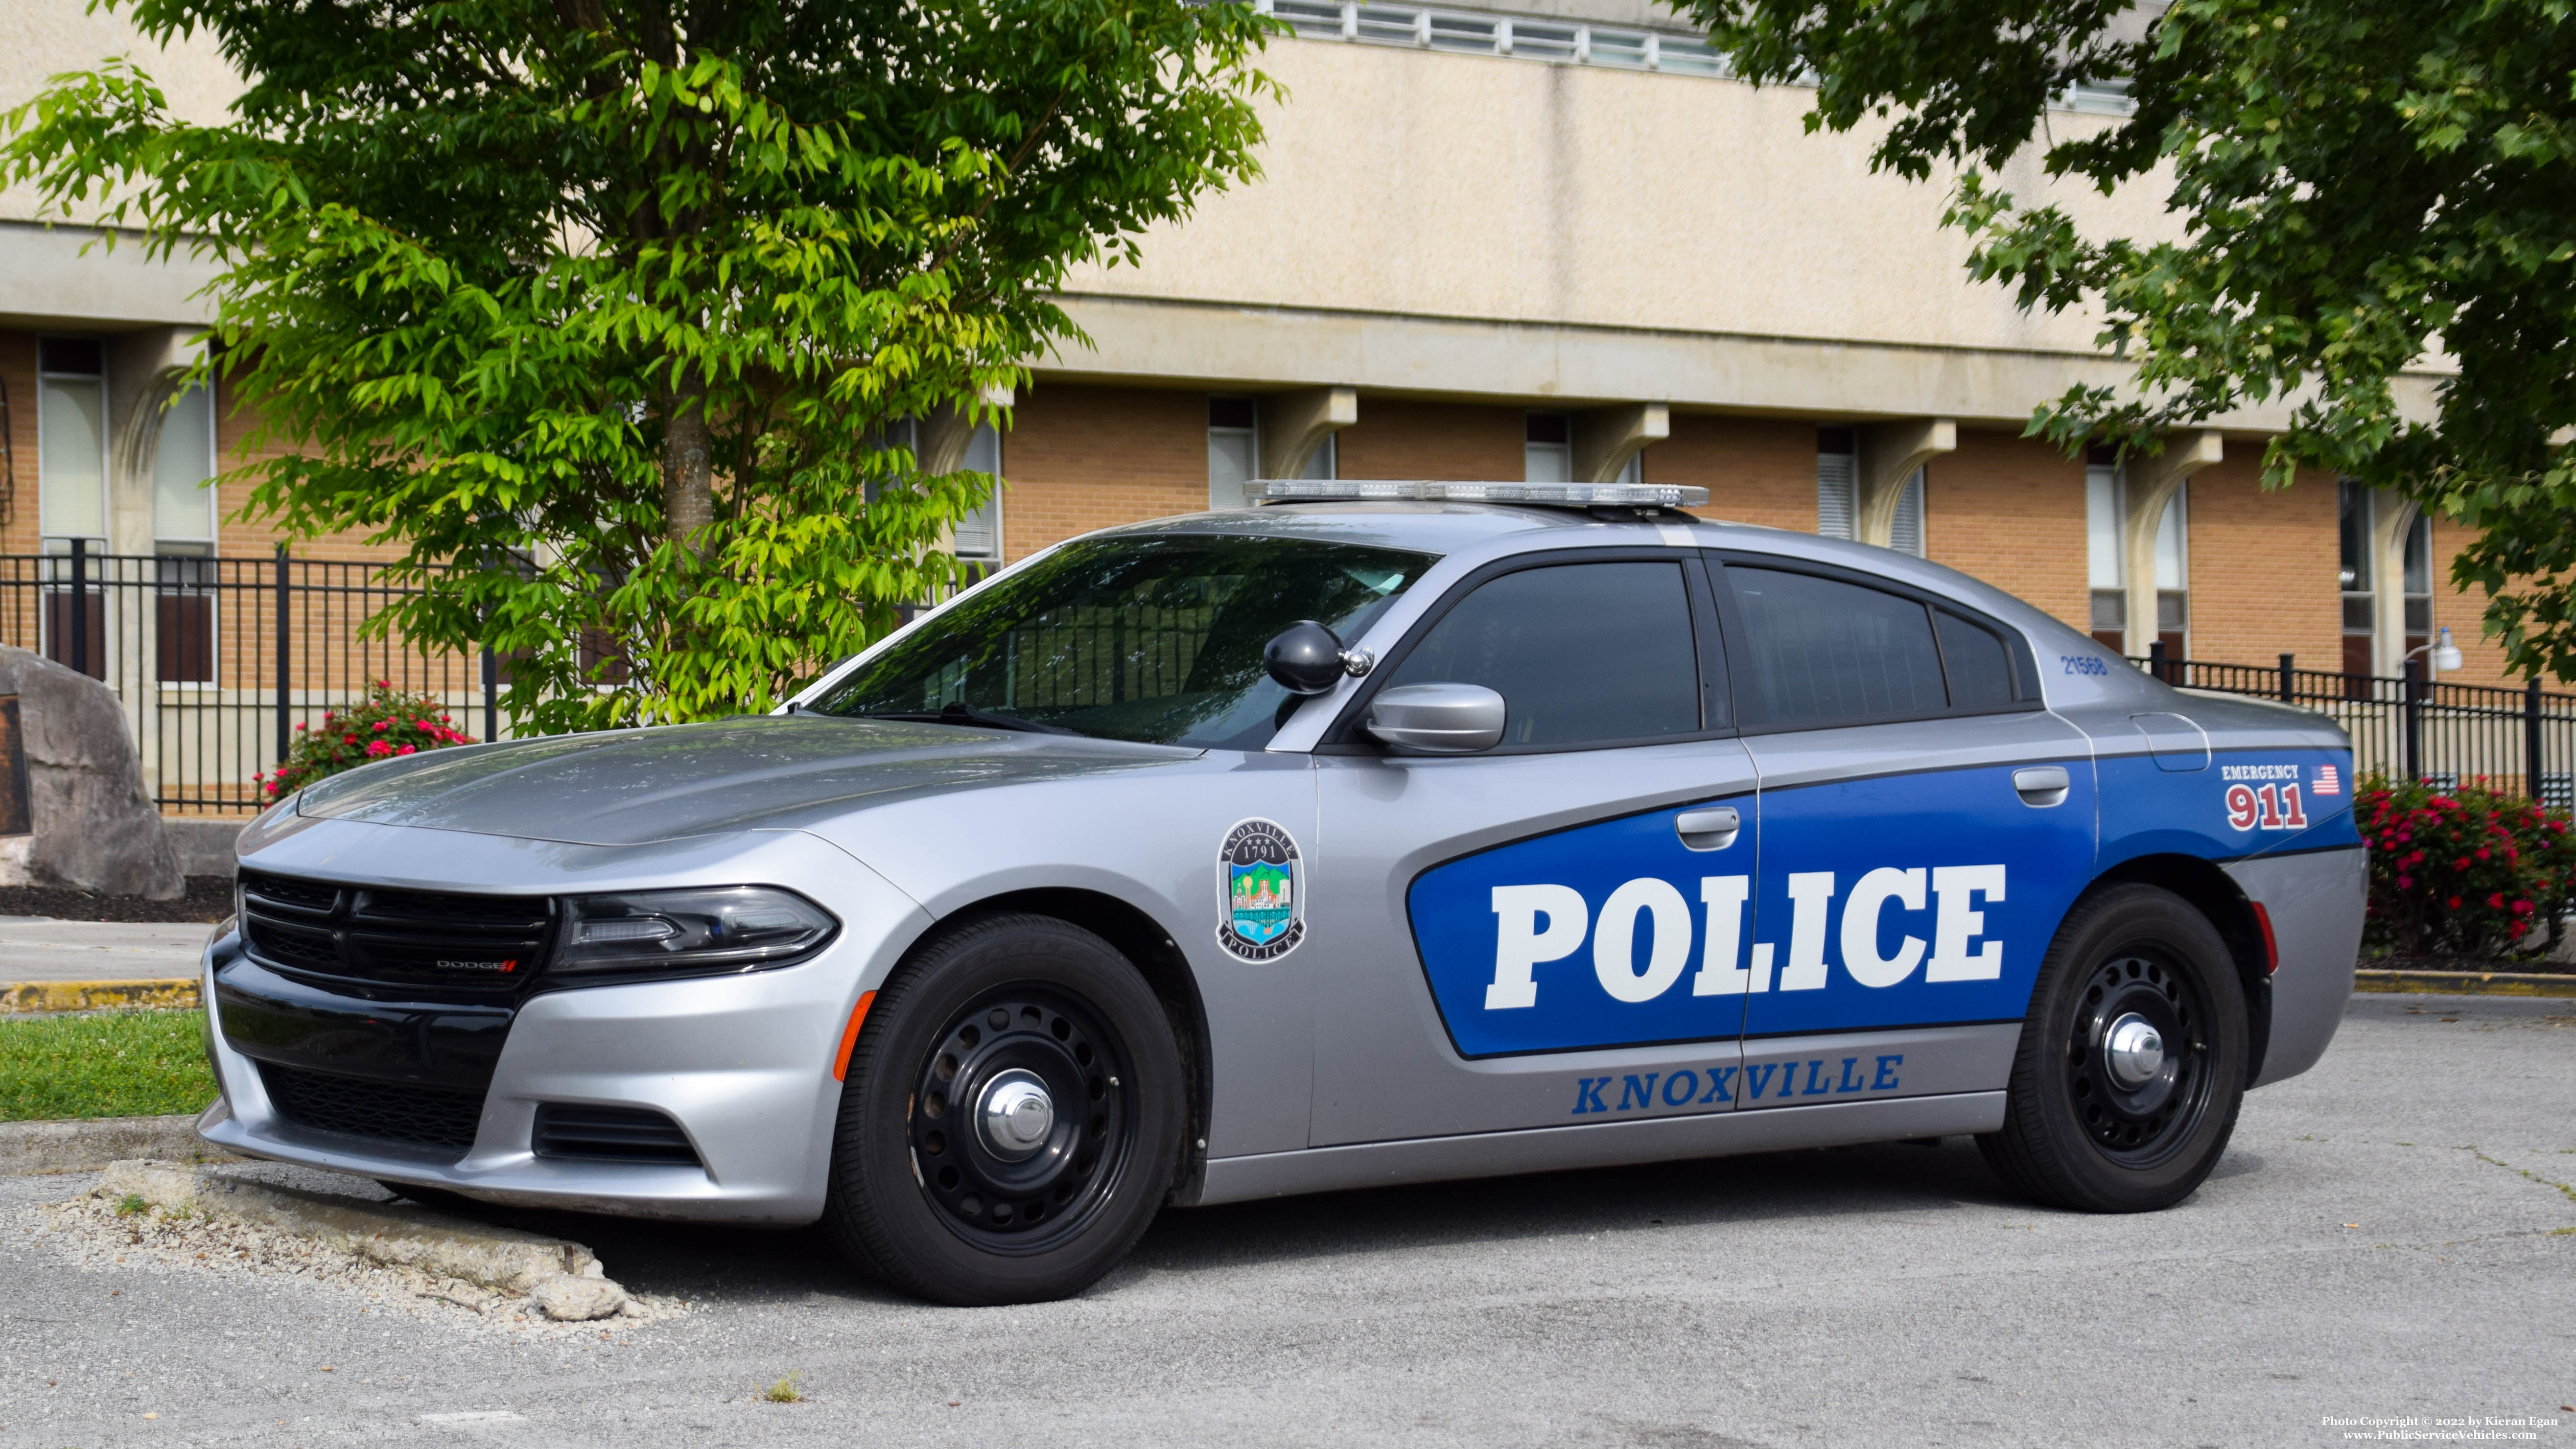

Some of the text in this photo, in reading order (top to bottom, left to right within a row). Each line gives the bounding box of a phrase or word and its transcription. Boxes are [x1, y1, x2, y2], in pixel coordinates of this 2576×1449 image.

[2061, 655, 2108, 676] 21568
[2221, 765, 2298, 780] EMERGENCY
[2225, 783, 2308, 831] 911
[1224, 822, 1295, 857] KNOXVILLE
[1244, 845, 1275, 859] 1791
[1227, 936, 1296, 959] POLICE
[1484, 864, 2006, 1010] POLICE
[437, 960, 507, 969] DODGE
[1571, 1054, 1904, 1115] KNOXVILLE
